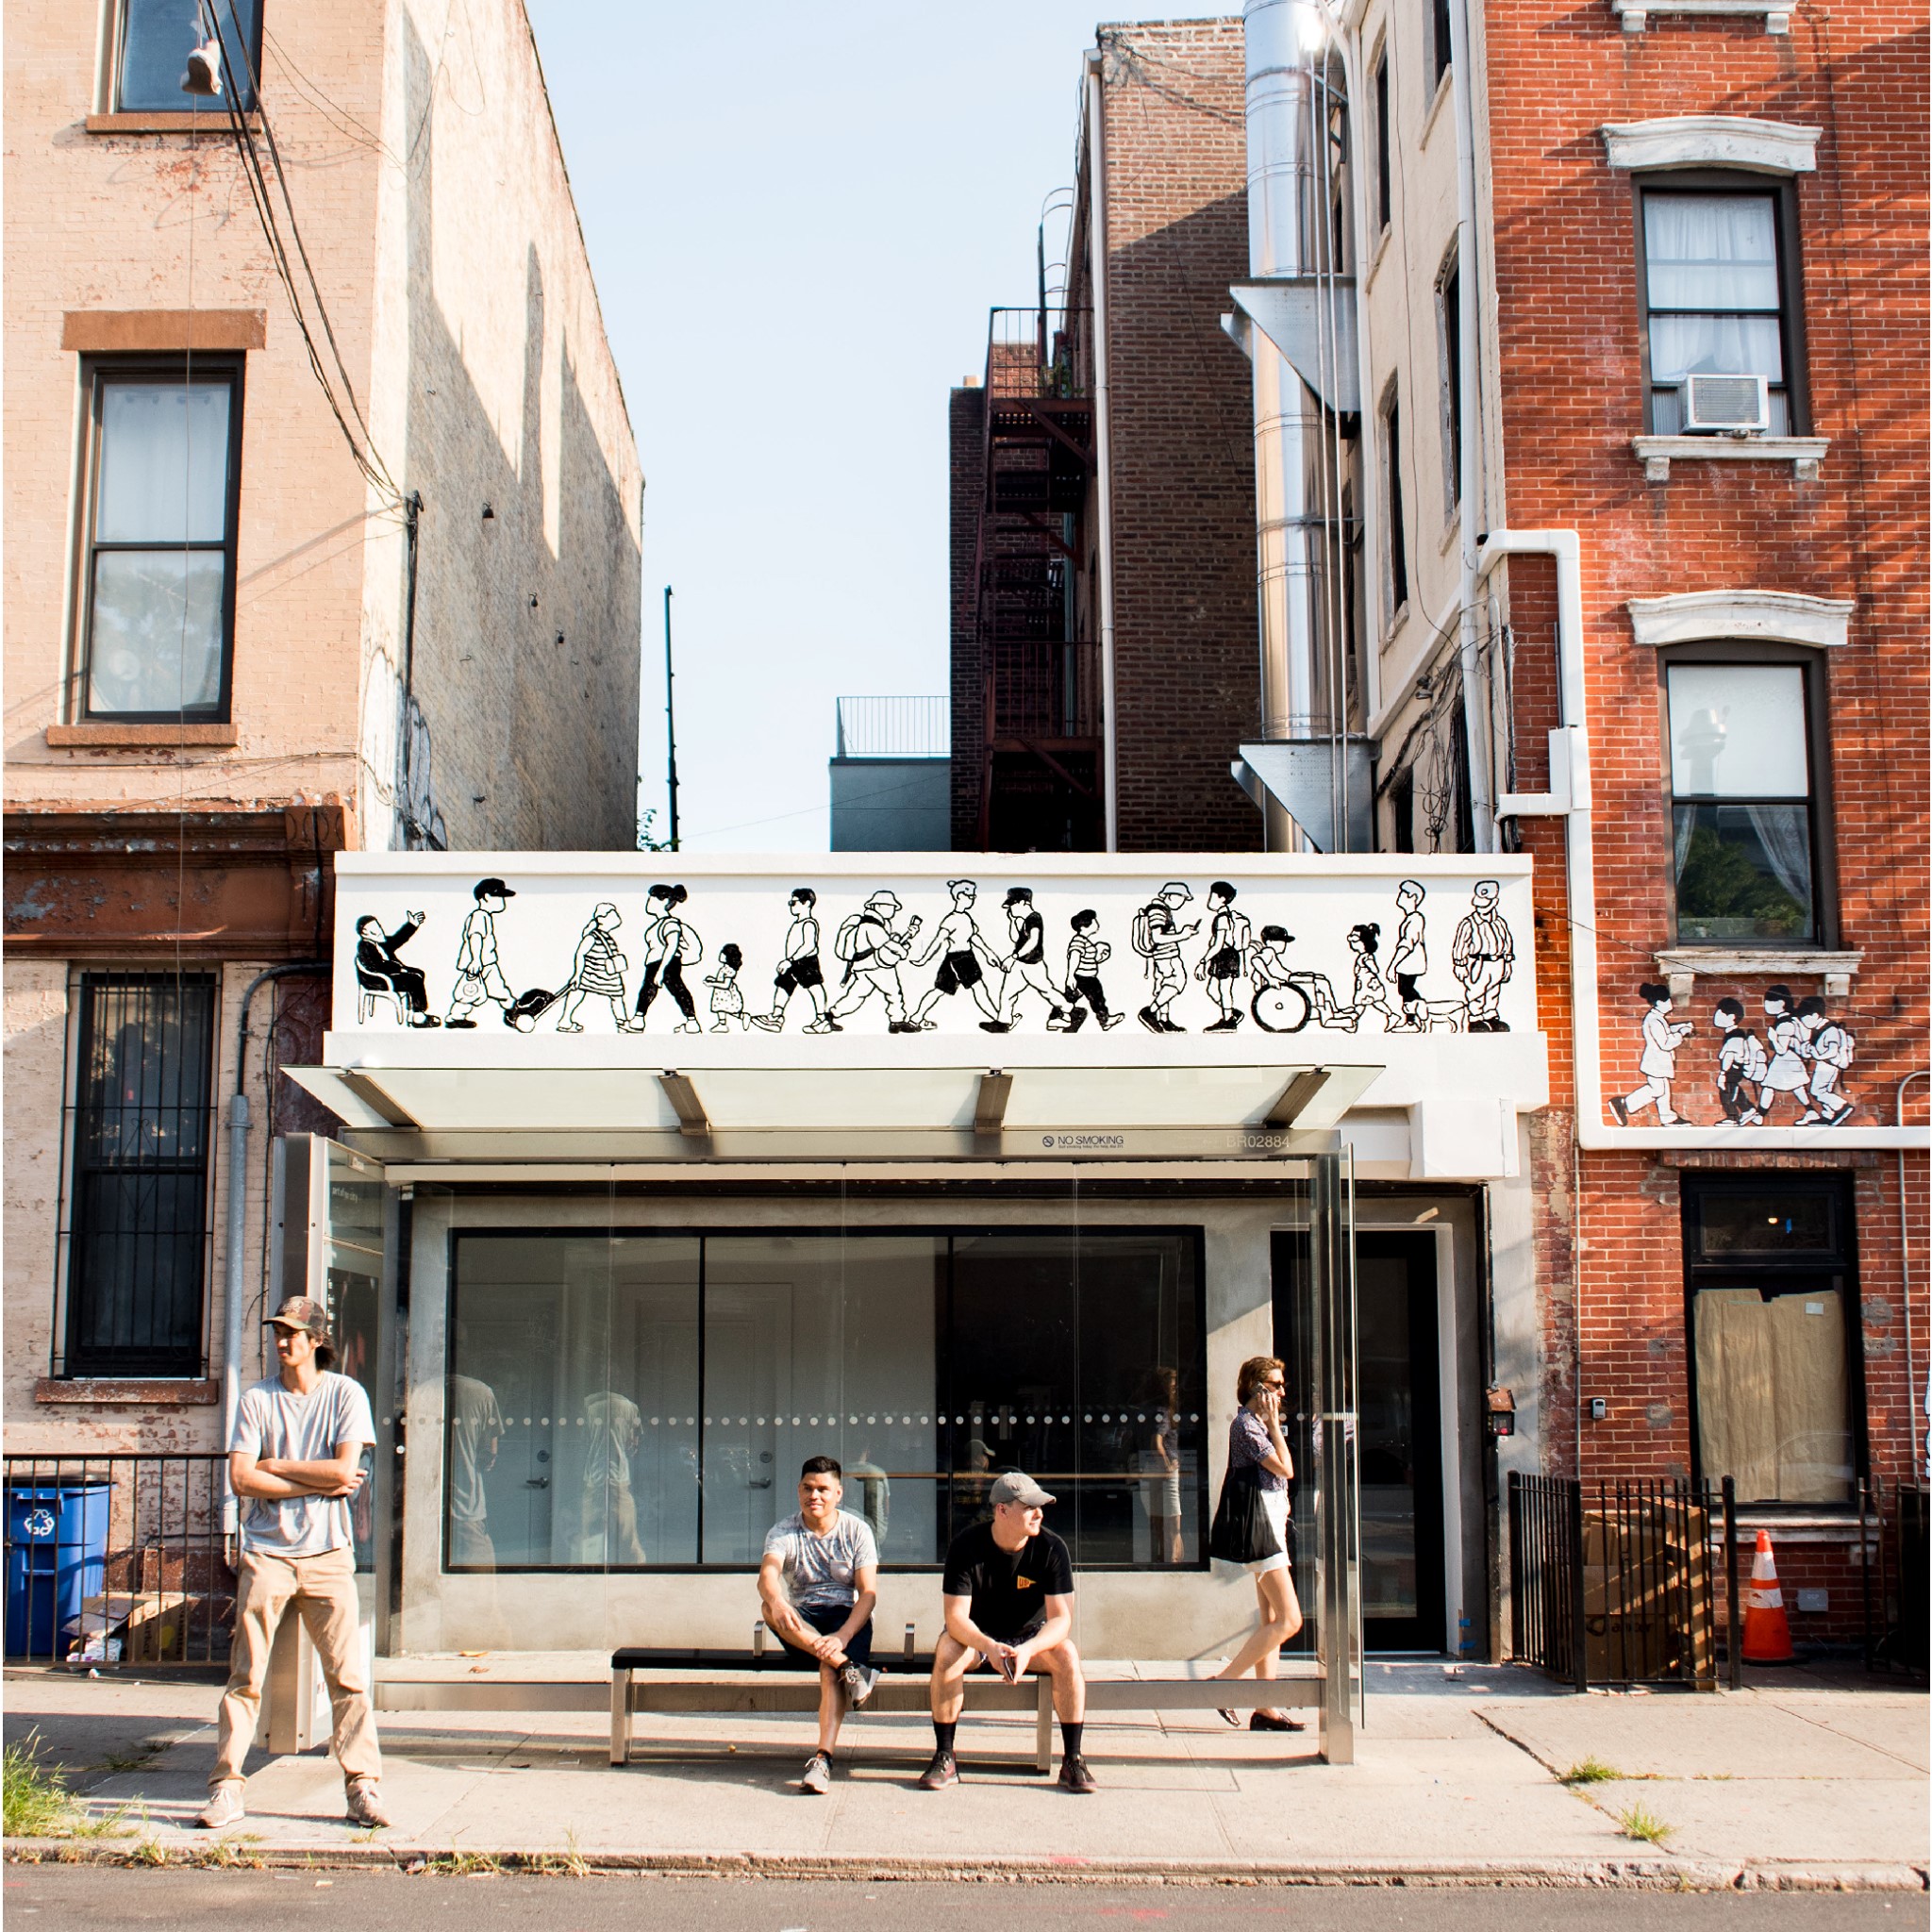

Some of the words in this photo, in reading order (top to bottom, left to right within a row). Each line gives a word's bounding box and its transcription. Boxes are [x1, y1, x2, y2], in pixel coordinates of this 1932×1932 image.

[1058, 1135, 1074, 1144] NO
[1075, 1135, 1124, 1144] SMOKING
[1226, 1135, 1291, 1148] BR02884
